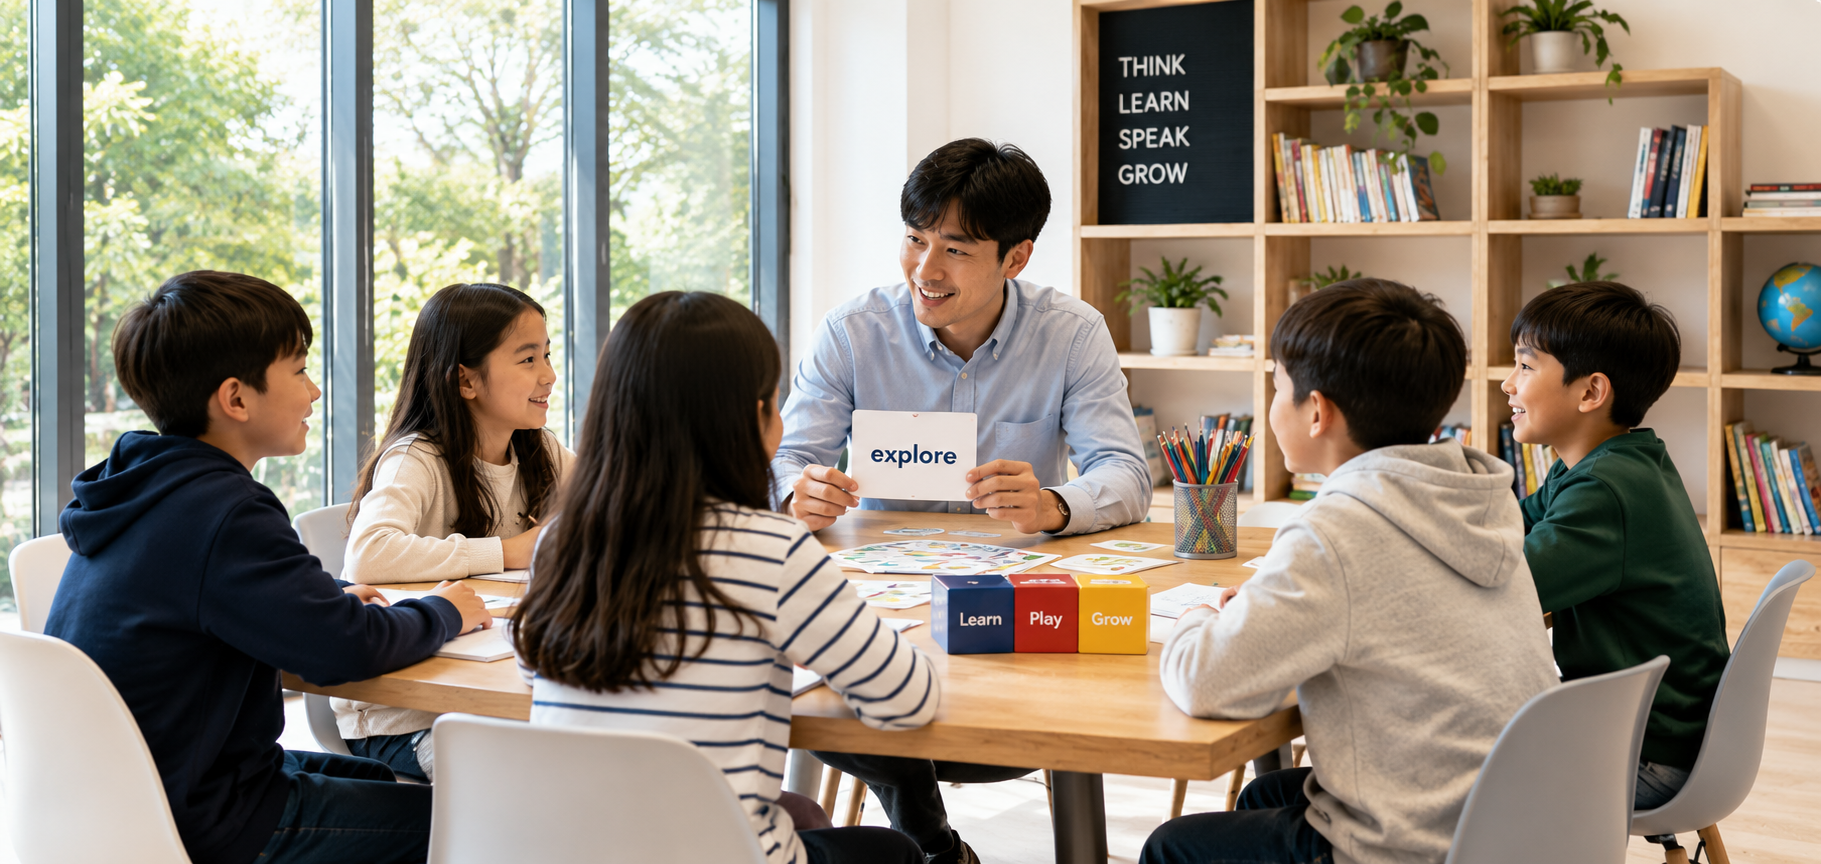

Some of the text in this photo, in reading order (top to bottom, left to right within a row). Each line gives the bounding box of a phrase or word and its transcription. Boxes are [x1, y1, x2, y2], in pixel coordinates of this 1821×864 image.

[1119, 54, 1185, 77] THINK
[1120, 91, 1189, 113] LEARN
[1119, 126, 1190, 149] SPEAK
[1119, 163, 1188, 184] GROW
[871, 444, 956, 468] explore
[961, 613, 1001, 626] Learn
[1030, 611, 1062, 629] Play
[1092, 612, 1133, 625] Grow
